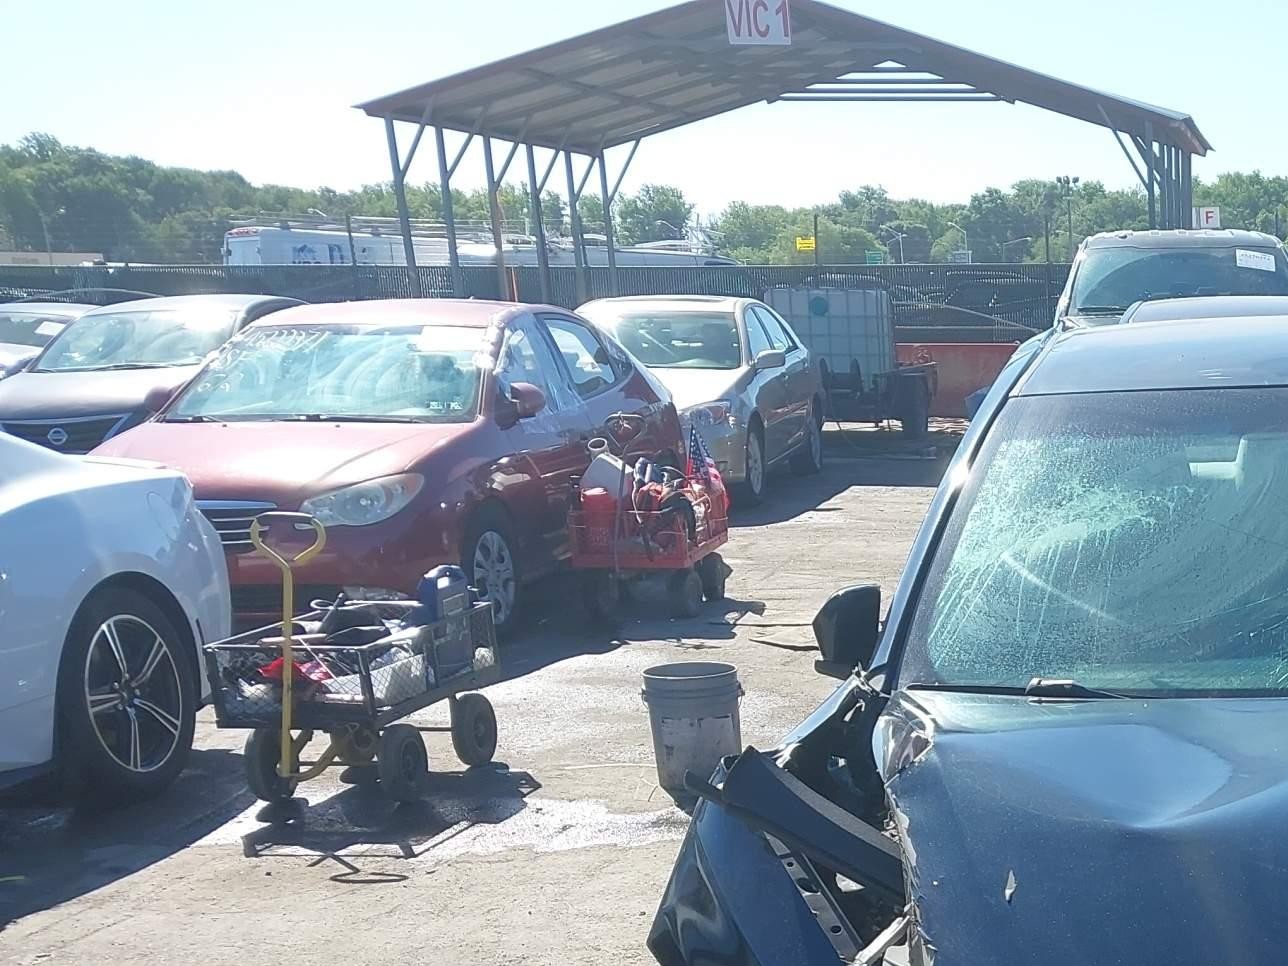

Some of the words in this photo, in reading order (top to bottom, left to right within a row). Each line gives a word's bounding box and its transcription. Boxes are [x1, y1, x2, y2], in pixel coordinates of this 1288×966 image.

[725, 0, 770, 38] VIC
[776, 0, 790, 38] 1
[1205, 211, 1214, 224] F
